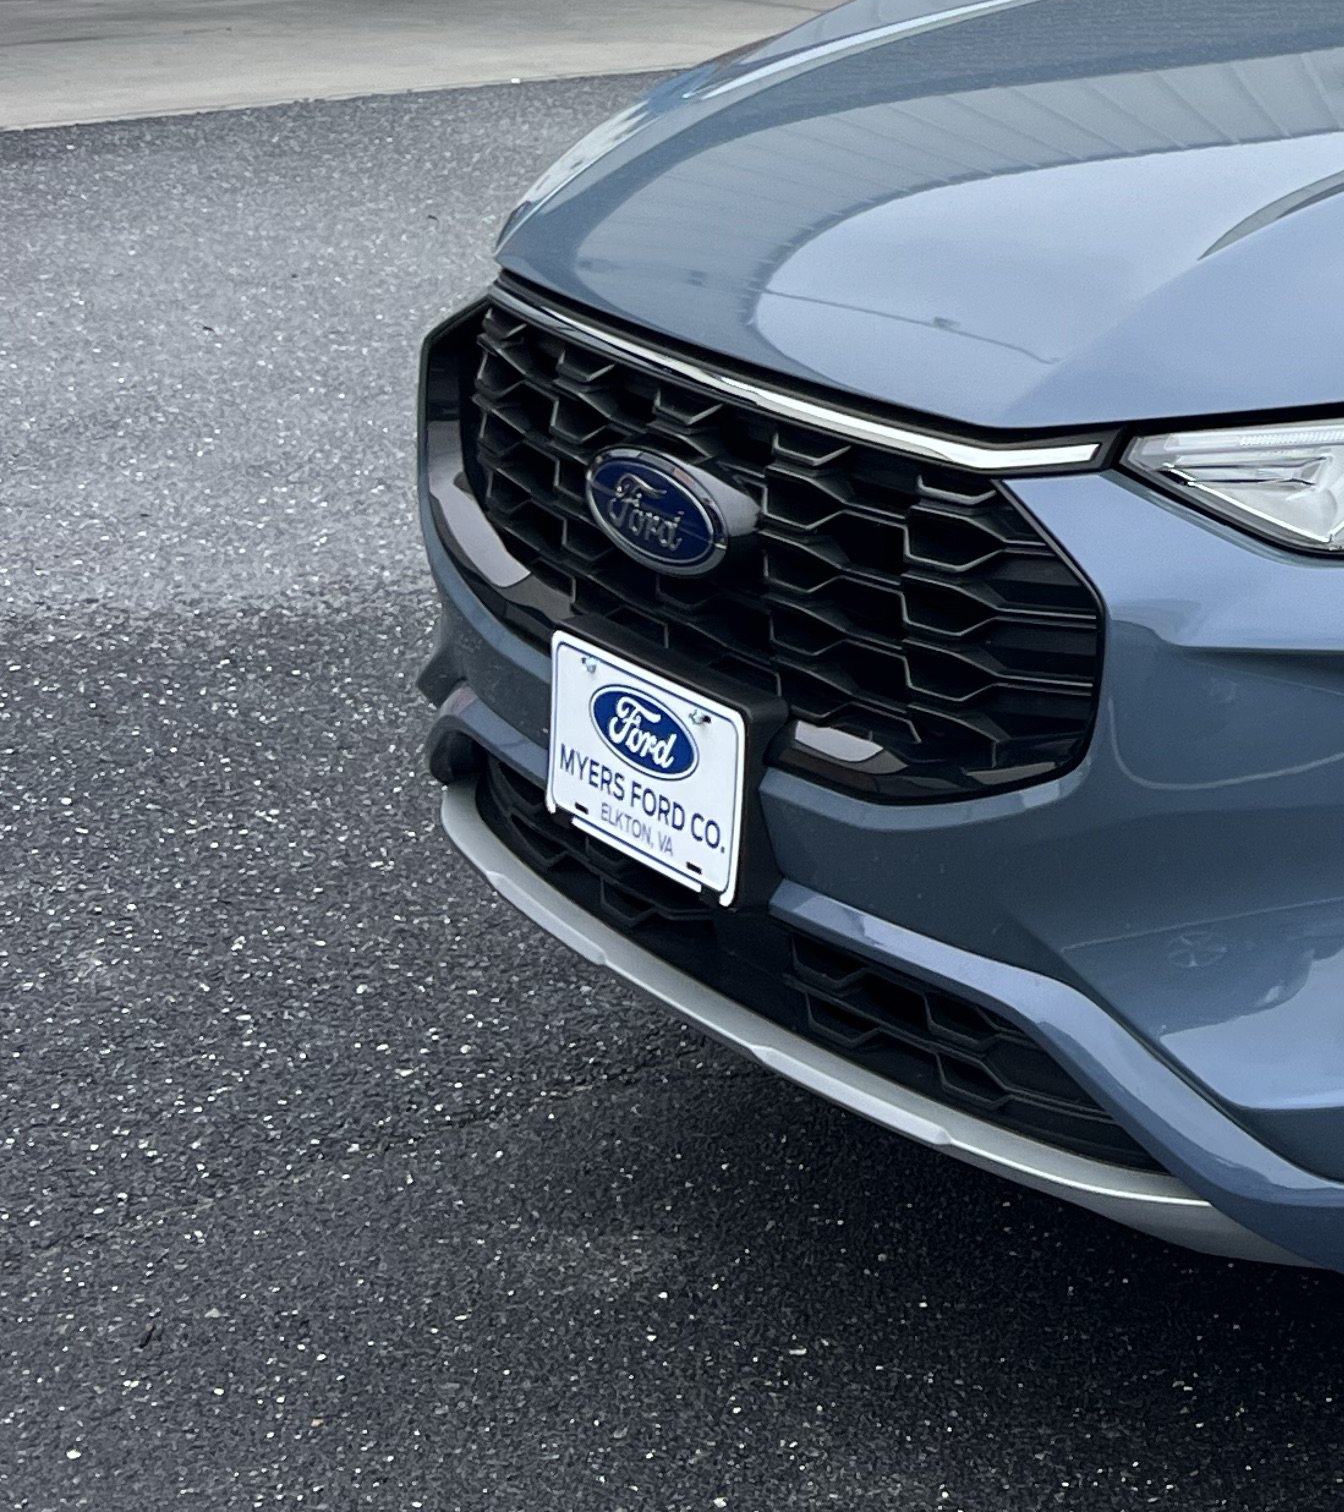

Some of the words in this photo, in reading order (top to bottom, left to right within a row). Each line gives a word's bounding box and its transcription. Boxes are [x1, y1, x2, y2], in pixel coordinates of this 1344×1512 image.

[608, 472, 686, 551] Ford
[606, 693, 678, 769] Ford
[559, 742, 626, 803] MYERS
[631, 778, 686, 834] FORD
[690, 810, 726, 854] CO.
[600, 801, 654, 848] ELKTON,
[657, 830, 675, 857] VA
